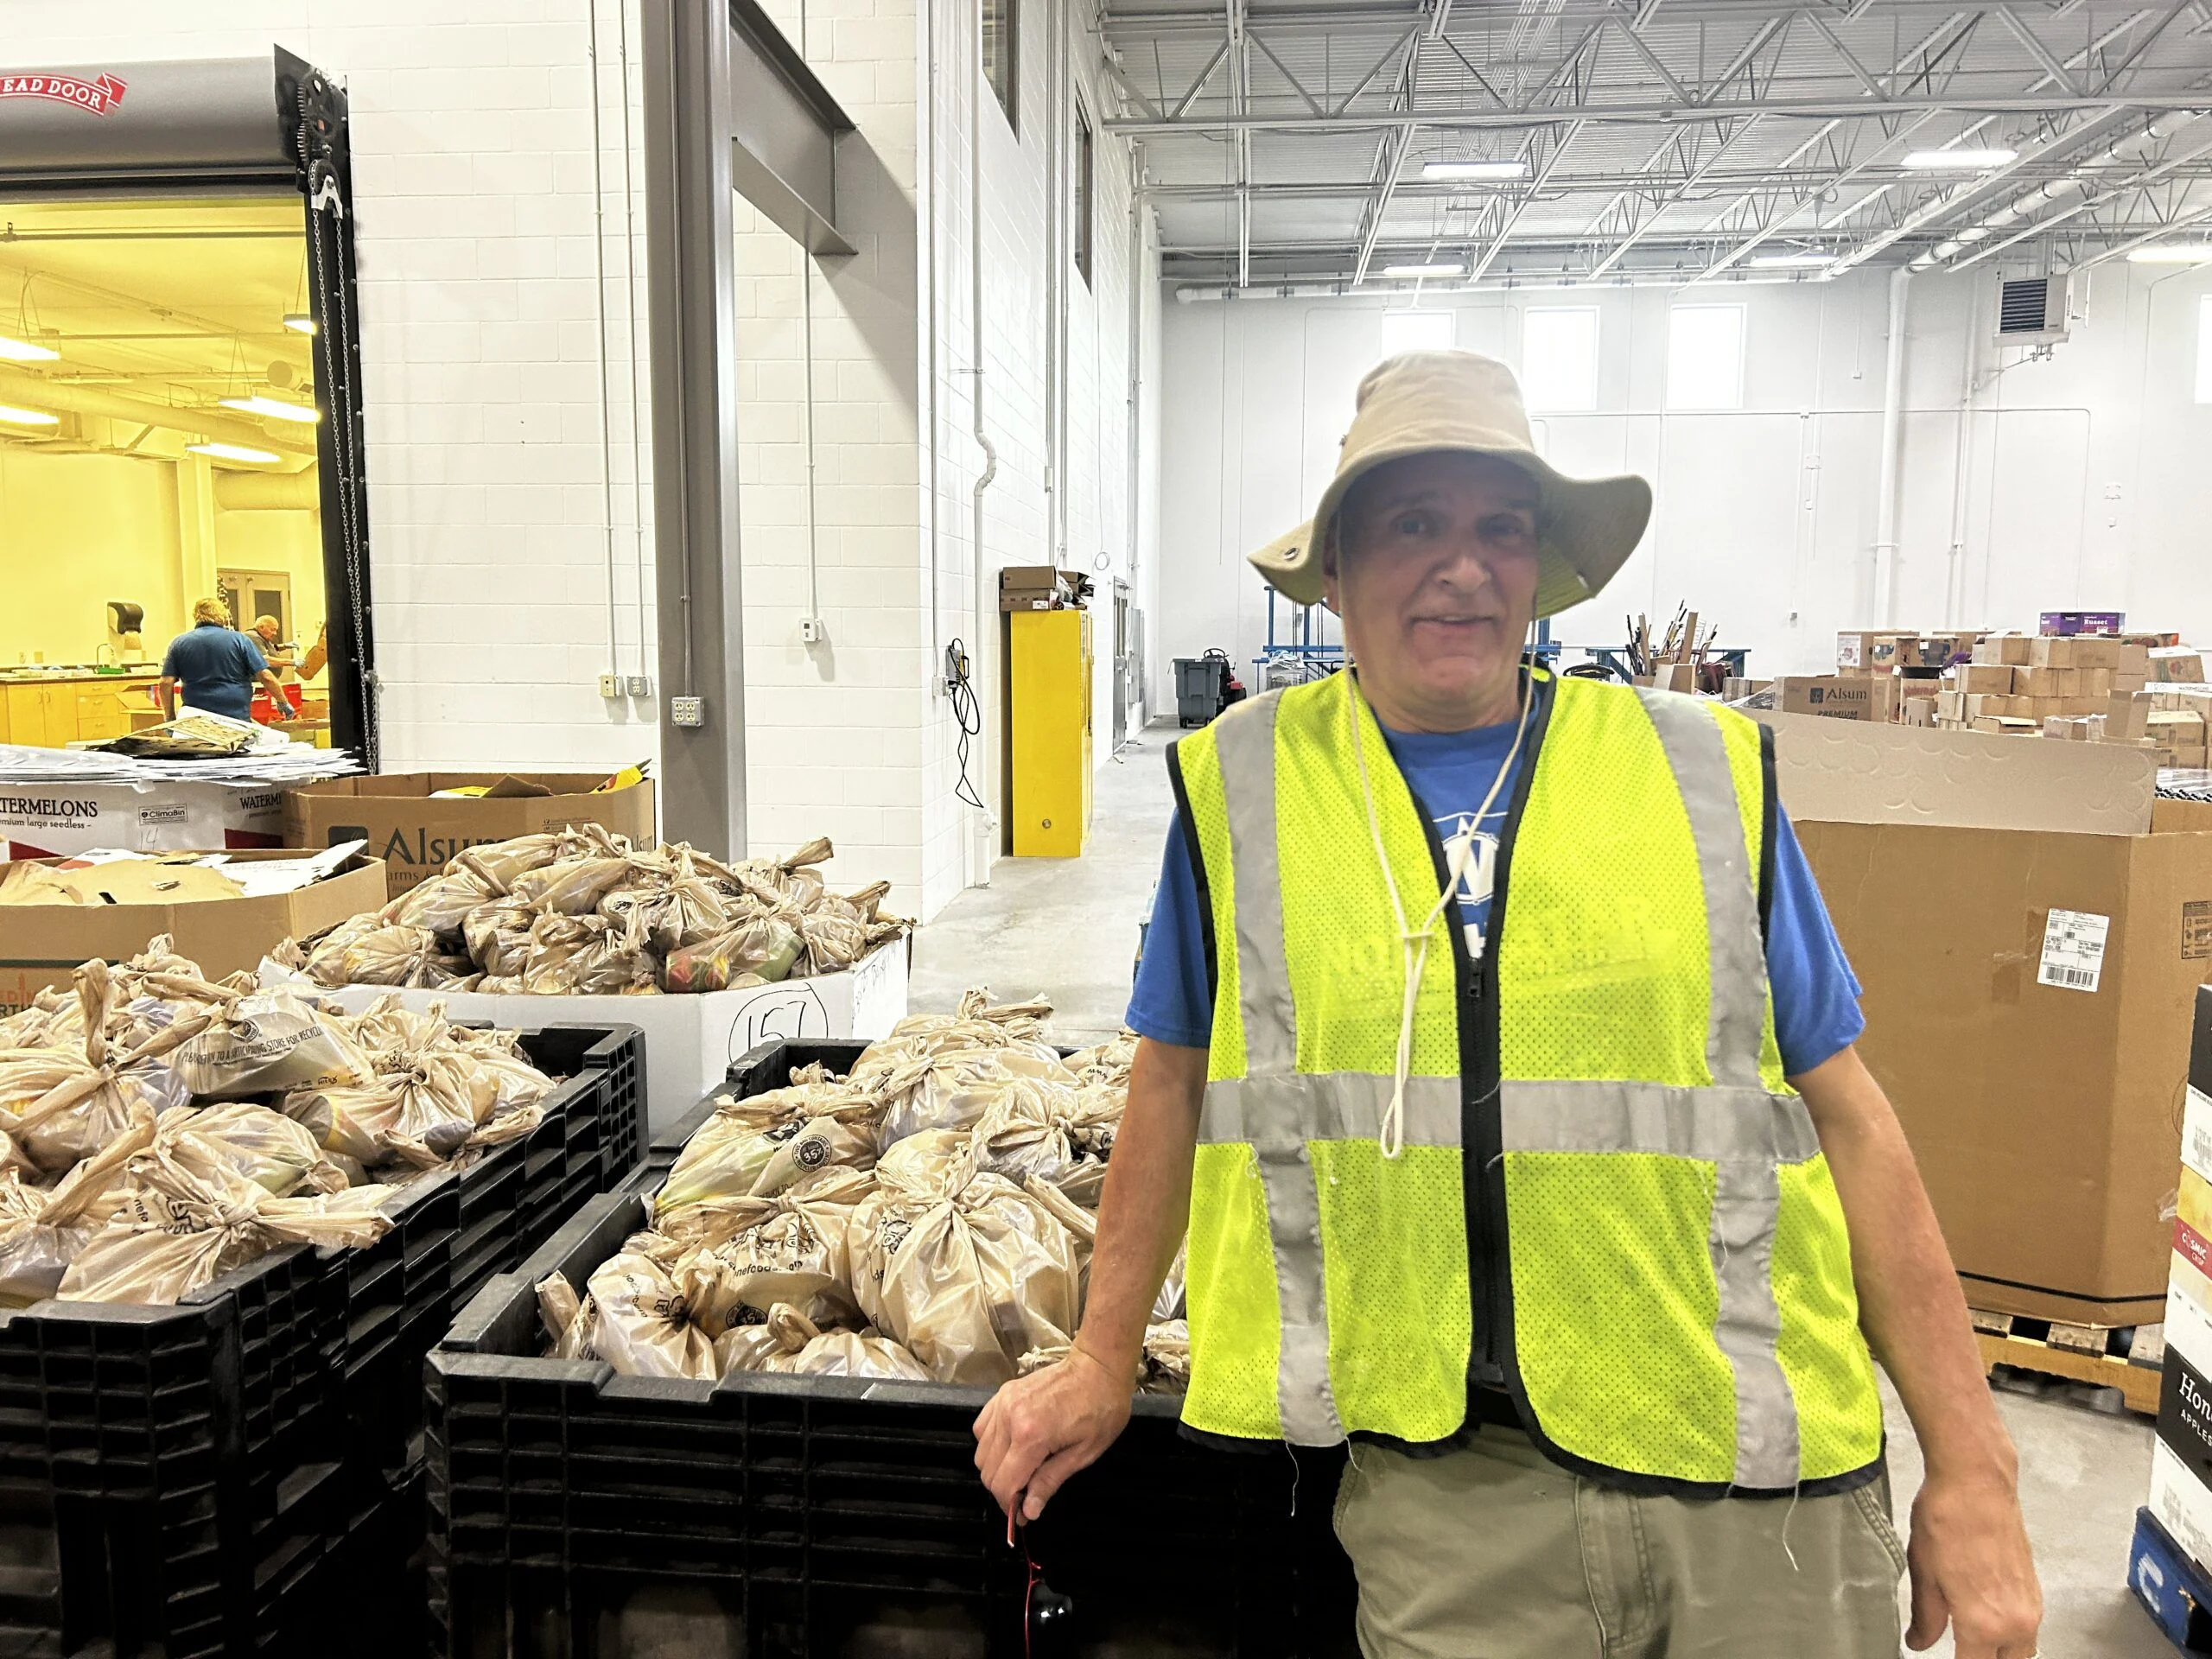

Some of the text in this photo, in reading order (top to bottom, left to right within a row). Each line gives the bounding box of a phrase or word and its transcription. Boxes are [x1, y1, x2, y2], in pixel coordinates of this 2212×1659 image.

[48, 79, 101, 109] DOOR
[1826, 687, 1867, 700] Alsum
[0, 797, 99, 817] TERMELONS
[149, 809, 185, 818] ClimaBin
[27, 816, 48, 830] large
[50, 818, 85, 830] seedless
[382, 827, 508, 865] Alsu
[266, 1038, 286, 1052] STORE
[285, 1034, 300, 1045] FOR
[2182, 1228, 2208, 1261] COSMIC
[2178, 1371, 2212, 1421] Hon
[2180, 1408, 2212, 1447] APPLES
